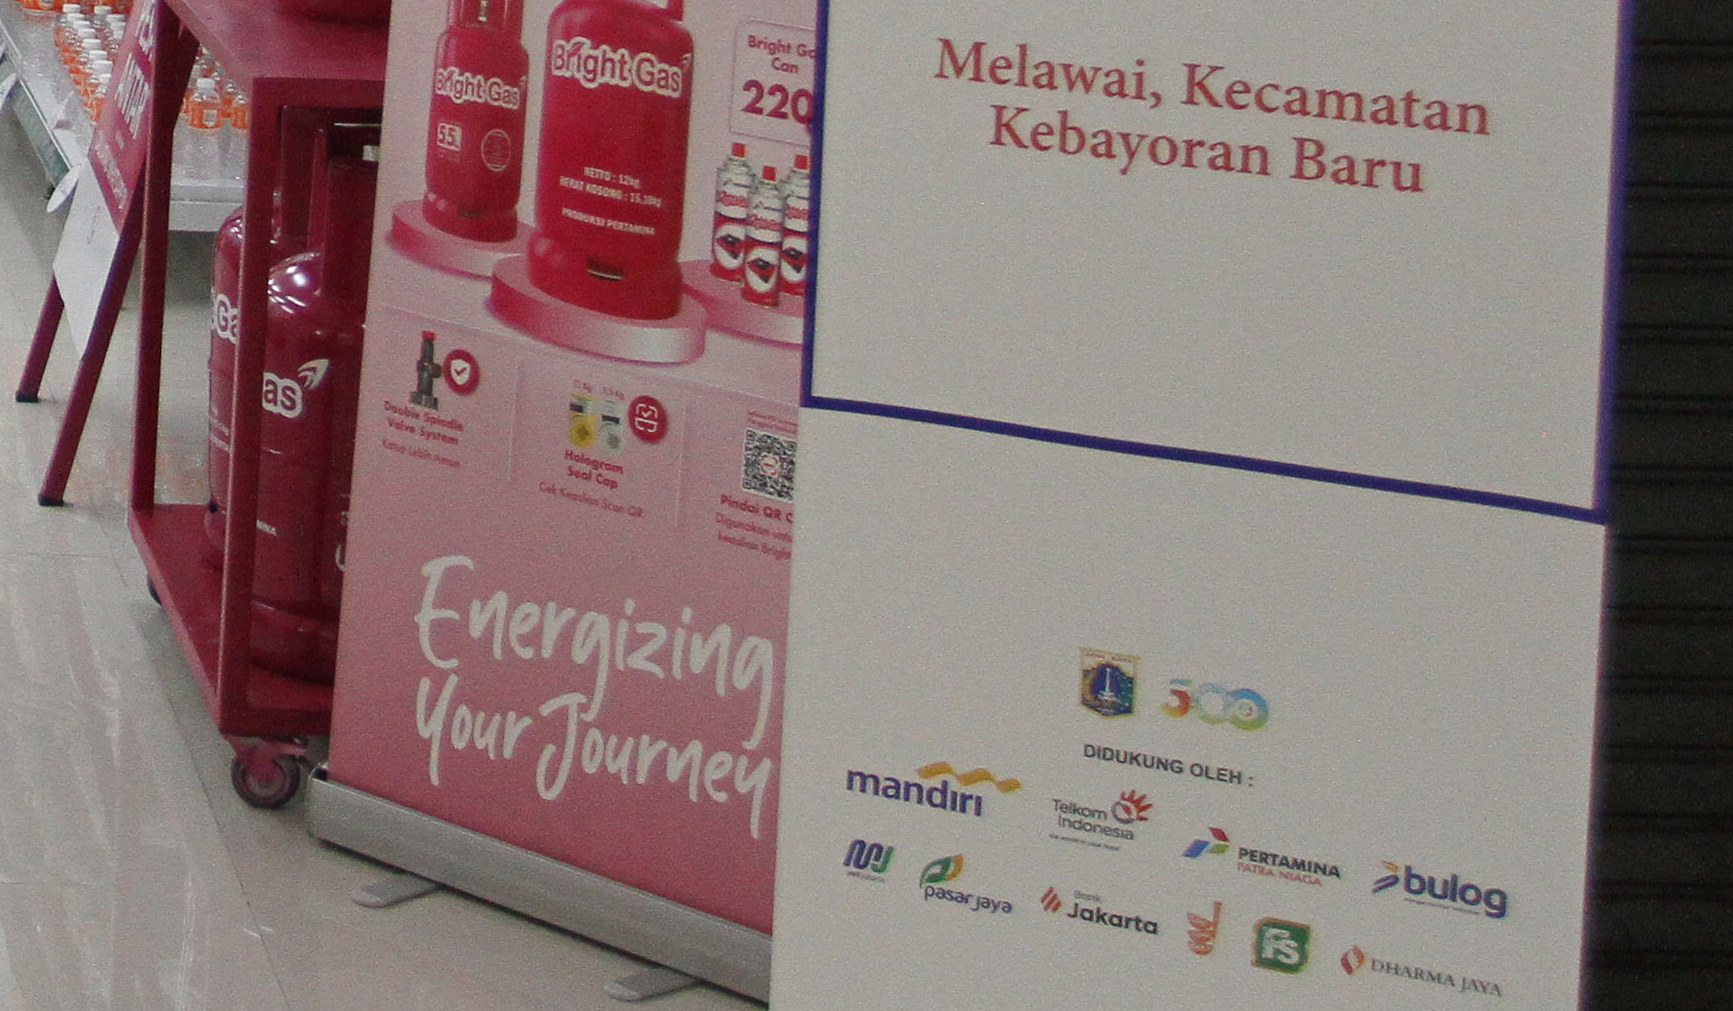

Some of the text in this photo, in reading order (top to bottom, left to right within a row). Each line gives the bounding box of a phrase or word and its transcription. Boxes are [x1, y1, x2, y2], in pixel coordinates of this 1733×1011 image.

[747, 33, 816, 59] Bright Ga
[551, 36, 684, 97] Bright Gas
[770, 56, 800, 75] Can
[435, 66, 520, 110] Bright Gas
[741, 79, 814, 125] 220
[933, 37, 1492, 136] Melawai, Kecamatan
[988, 103, 1426, 194] Kebayoran Baru
[384, 400, 421, 420] Double
[419, 426, 459, 446] System
[564, 449, 624, 475] Hologram
[567, 465, 619, 491] Seal Cap
[720, 493, 760, 515] Pindai
[762, 505, 782, 522] QR
[414, 554, 774, 752] Energizing
[415, 673, 774, 840] Your Journey
[1083, 742, 1185, 776] DIDUKUNG
[1189, 762, 1243, 786] OLEH
[845, 768, 984, 818] mandiri
[1052, 797, 1108, 821] Telkom
[1057, 814, 1135, 841] Indonesia
[1236, 861, 1274, 878] PATRA
[1237, 846, 1342, 880] PERTAMINA
[923, 884, 1014, 915] pasar jaya
[1402, 864, 1509, 920] bulog
[1066, 901, 1160, 936] Jakarta
[1262, 927, 1301, 966] FS
[1369, 956, 1504, 998] DHARMA JAYA
